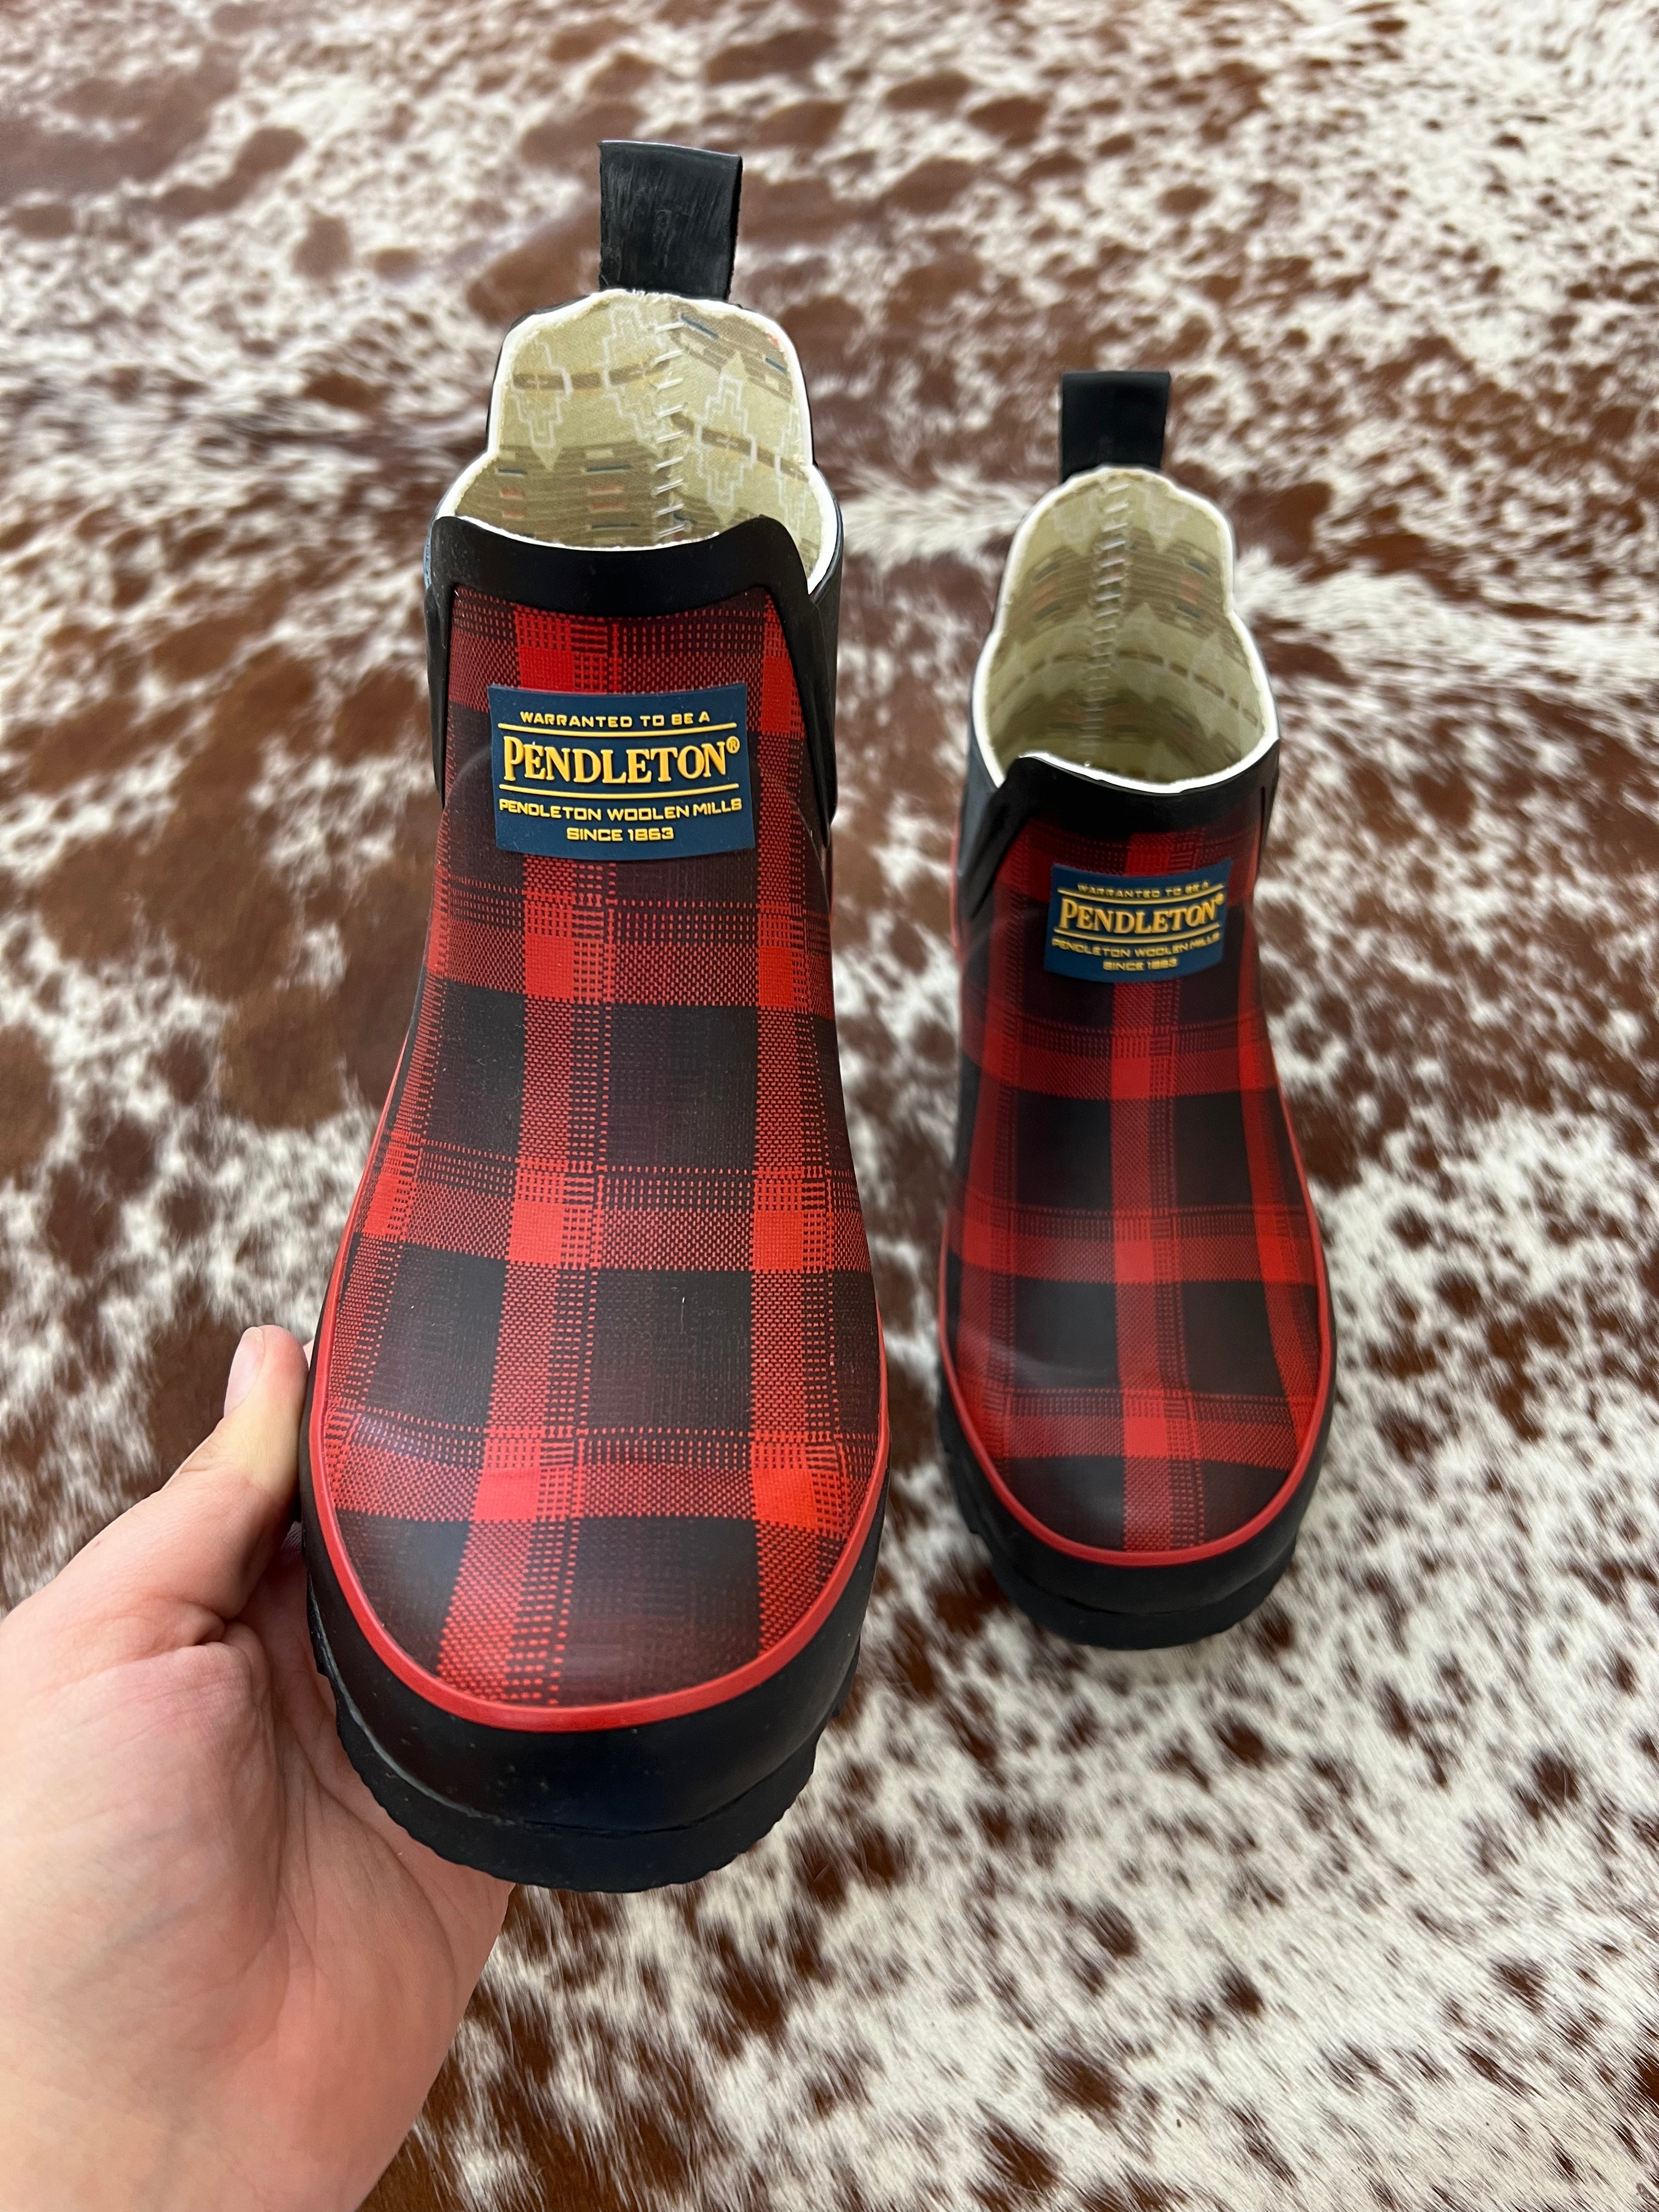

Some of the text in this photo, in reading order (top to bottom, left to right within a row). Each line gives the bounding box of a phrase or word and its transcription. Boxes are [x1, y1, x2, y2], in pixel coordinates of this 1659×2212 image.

[520, 712, 710, 727] WARRANTED TO BE A
[499, 798, 742, 821] PENDLETON WOOLEN MILLS
[567, 827, 674, 842] SINCE 1863
[1077, 883, 1160, 898] WARRANTED
[1165, 888, 1182, 896] TO
[1052, 938, 1131, 957] PENDLETON
[1134, 943, 1189, 957] WOOLEN
[1103, 961, 1144, 971] SINCE
